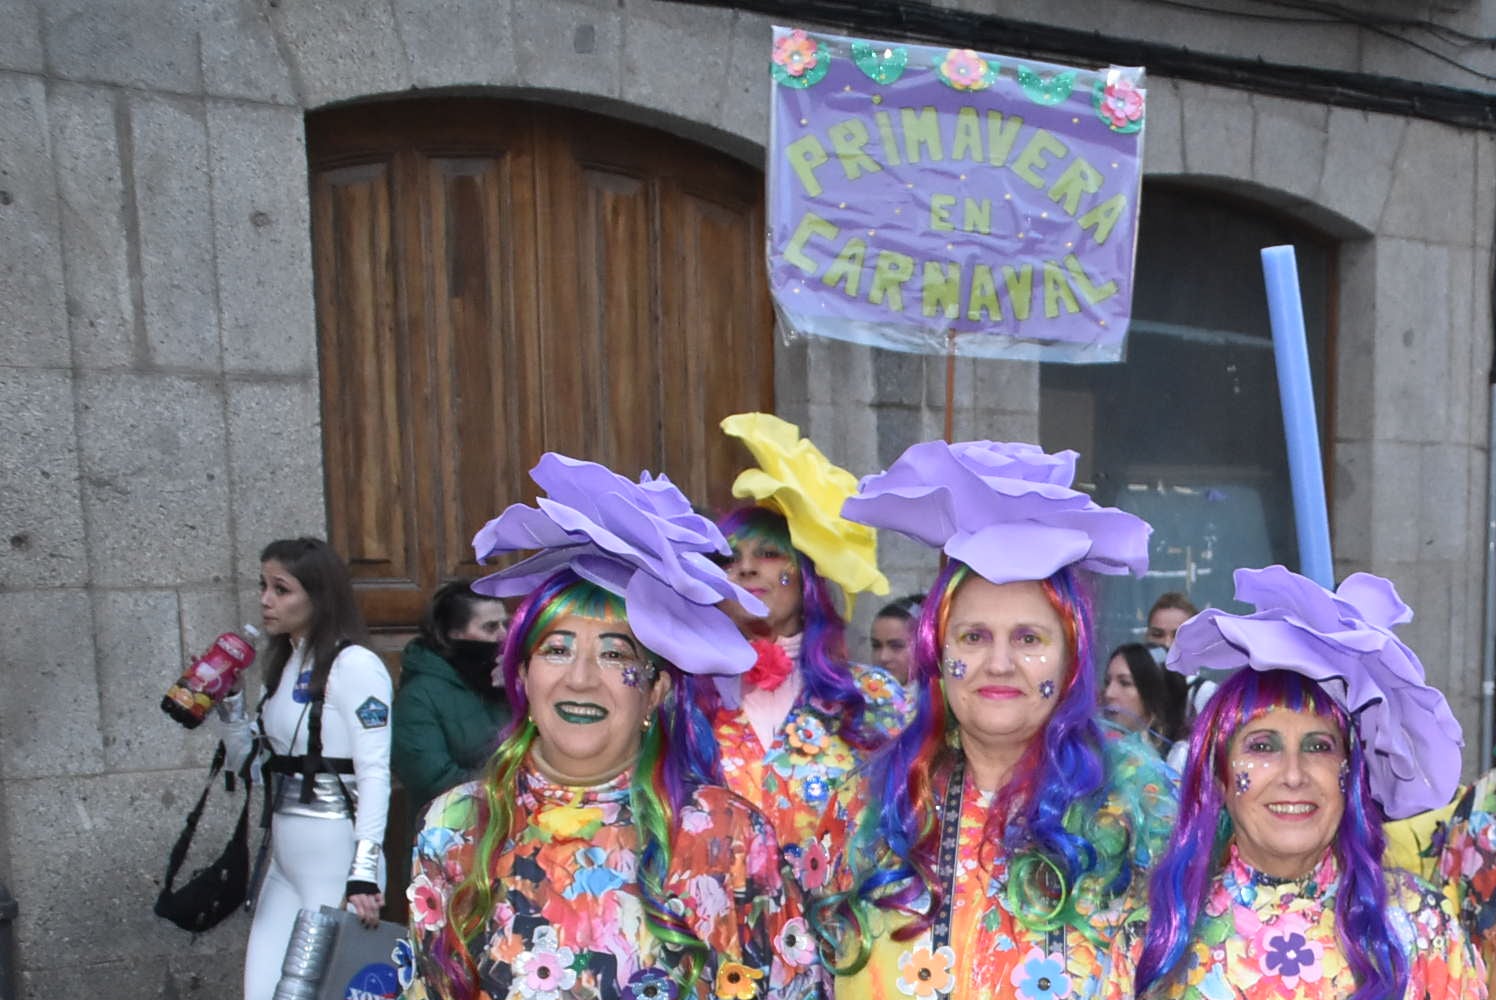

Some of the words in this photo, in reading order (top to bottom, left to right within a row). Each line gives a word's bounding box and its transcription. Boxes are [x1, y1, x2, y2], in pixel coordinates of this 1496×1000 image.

[785, 95, 1127, 245] PRIMAVERA
[930, 194, 992, 235] EN
[782, 211, 1119, 322] CARNAVAL
